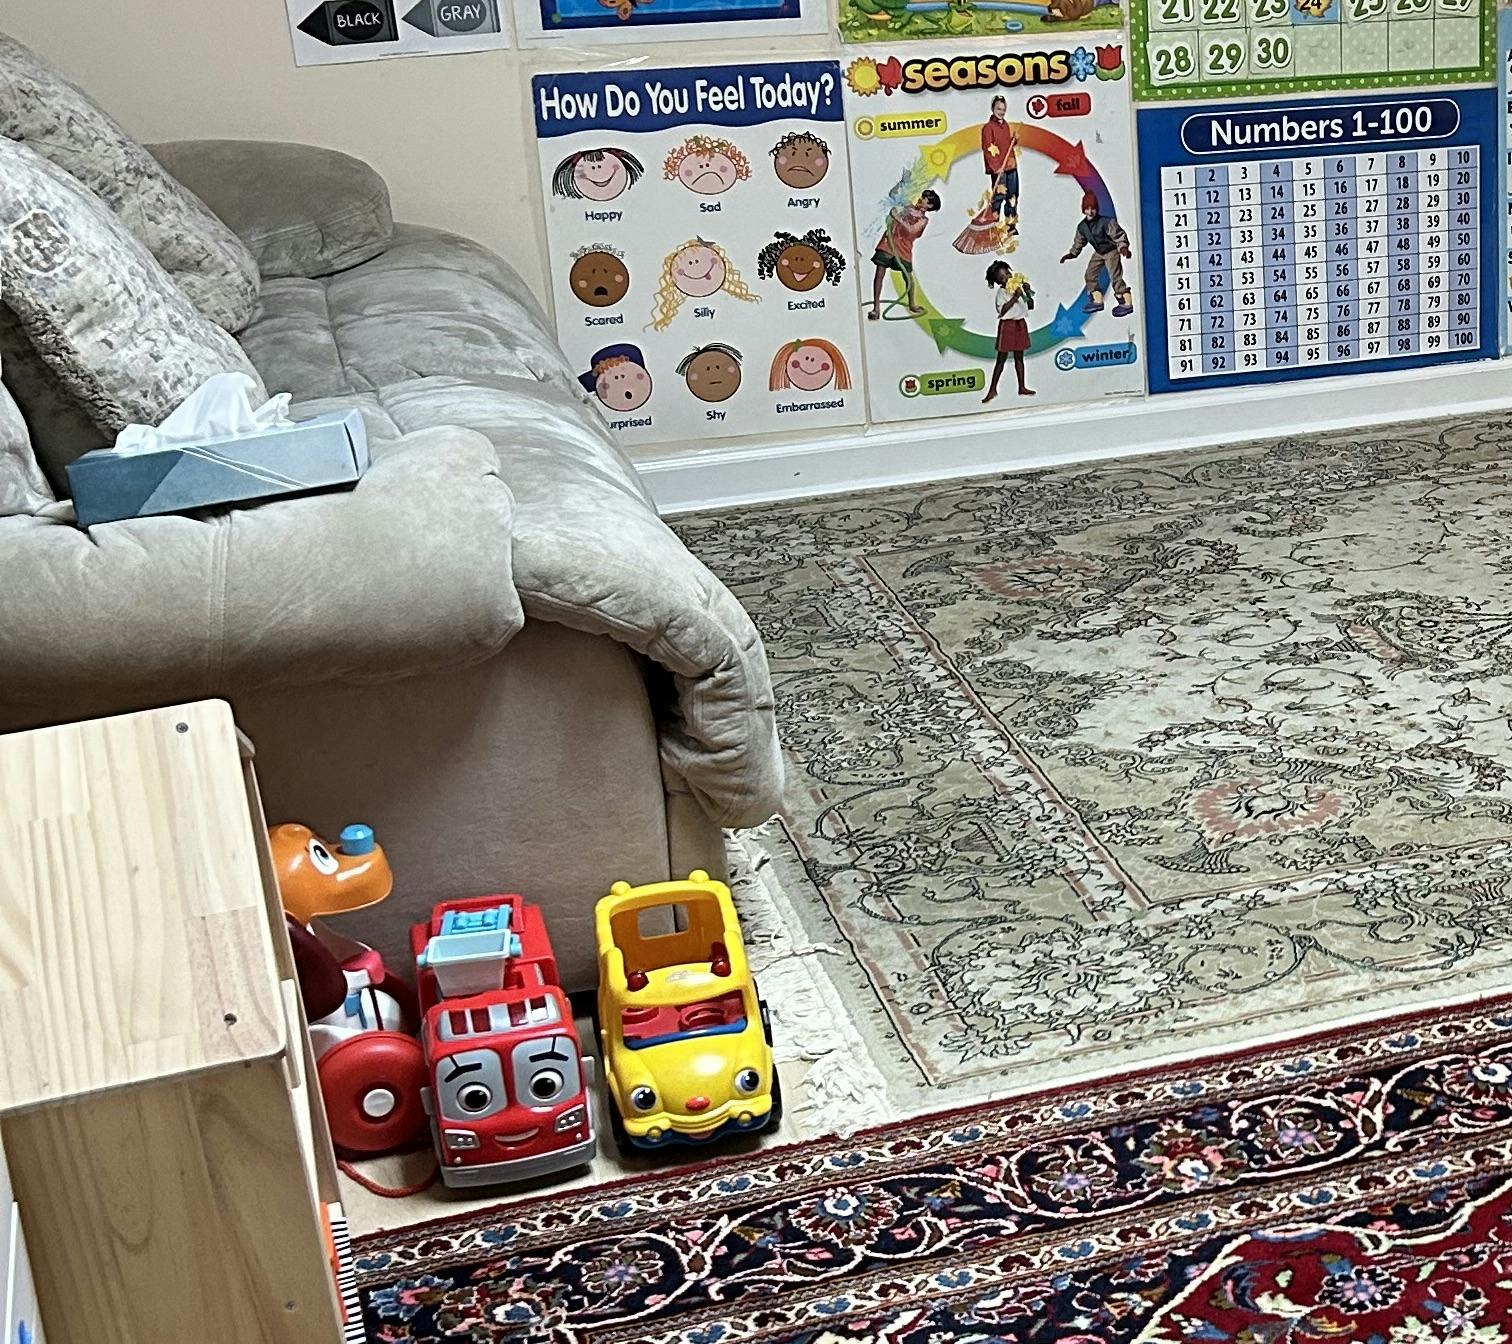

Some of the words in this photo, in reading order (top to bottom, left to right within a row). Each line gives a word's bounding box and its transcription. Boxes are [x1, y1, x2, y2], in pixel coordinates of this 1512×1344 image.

[337, 13, 381, 27] BLACK
[441, 5, 481, 22] GRAY
[1257, 38, 1289, 64] 30
[903, 54, 1069, 91] seasons
[539, 87, 598, 120] How
[605, 83, 640, 118] Do
[644, 81, 689, 115] You
[695, 75, 745, 112] Feel
[750, 72, 834, 114] Today?
[1056, 97, 1081, 111] fall
[880, 117, 942, 133] summer
[1210, 115, 1343, 146] Numbers
[1352, 106, 1433, 137] 1-100
[700, 201, 721, 212] Sad
[788, 197, 820, 208] Angry
[585, 211, 623, 225] Happy
[1457, 233, 1470, 246] 50
[788, 299, 825, 311] Excited
[585, 314, 624, 326] Scared
[694, 308, 716, 319] Silly
[1454, 332, 1473, 345] 100
[1081, 348, 1129, 363] winter
[927, 374, 976, 390] spring
[776, 399, 844, 413] Embarrassed
[706, 410, 726, 421] Shy
[609, 416, 652, 430] urprised
